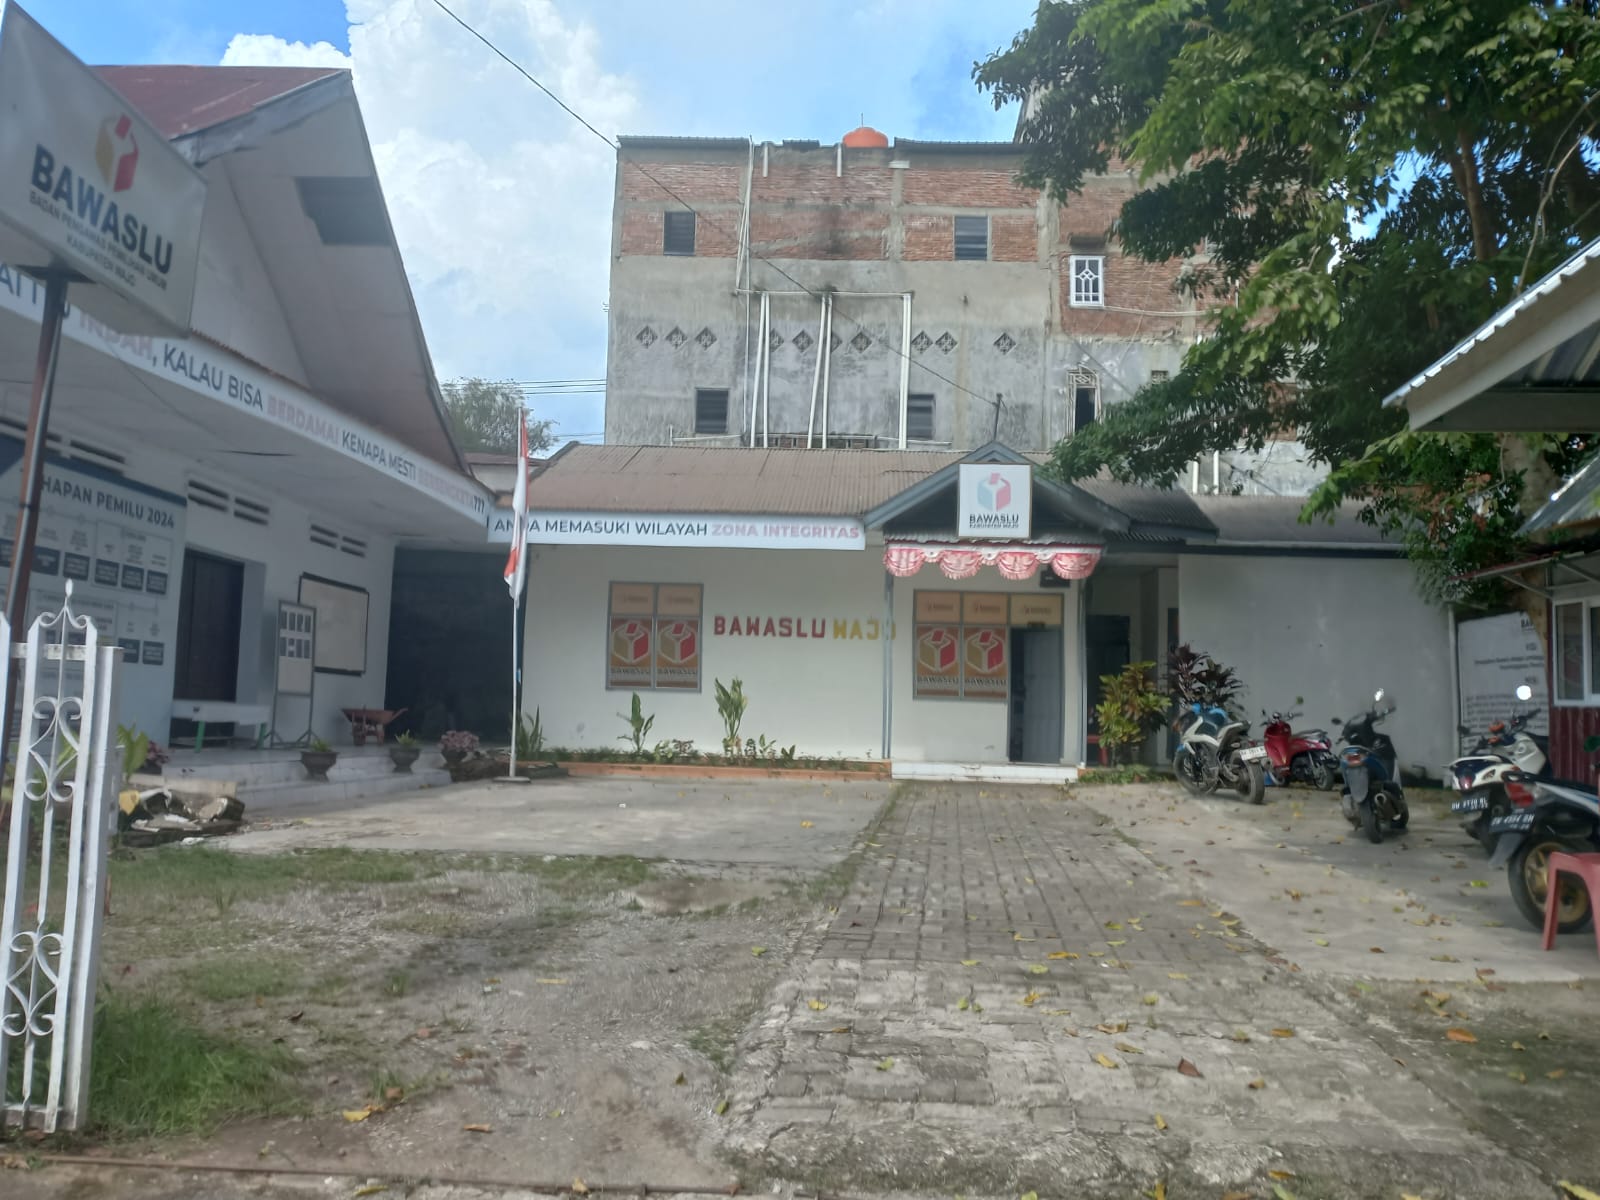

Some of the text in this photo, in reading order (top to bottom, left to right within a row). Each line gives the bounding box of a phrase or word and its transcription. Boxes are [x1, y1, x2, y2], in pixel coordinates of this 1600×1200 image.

[31, 143, 173, 274] BAWASLU
[163, 343, 223, 392] KALAU
[228, 375, 263, 411] BISA
[267, 395, 340, 445] BERDAMAI
[342, 430, 386, 467] KENAPA
[389, 451, 416, 481] MESTI
[96, 492, 144, 519] PEMILU
[147, 508, 175, 529] 2024
[969, 513, 1019, 523] BAWASLU
[545, 520, 630, 534] MEMASUKI
[635, 521, 707, 536] WILAYAH
[712, 524, 758, 537] ZONA
[763, 525, 860, 539] INTEGRITAS
[713, 616, 826, 638] BAWASLU
